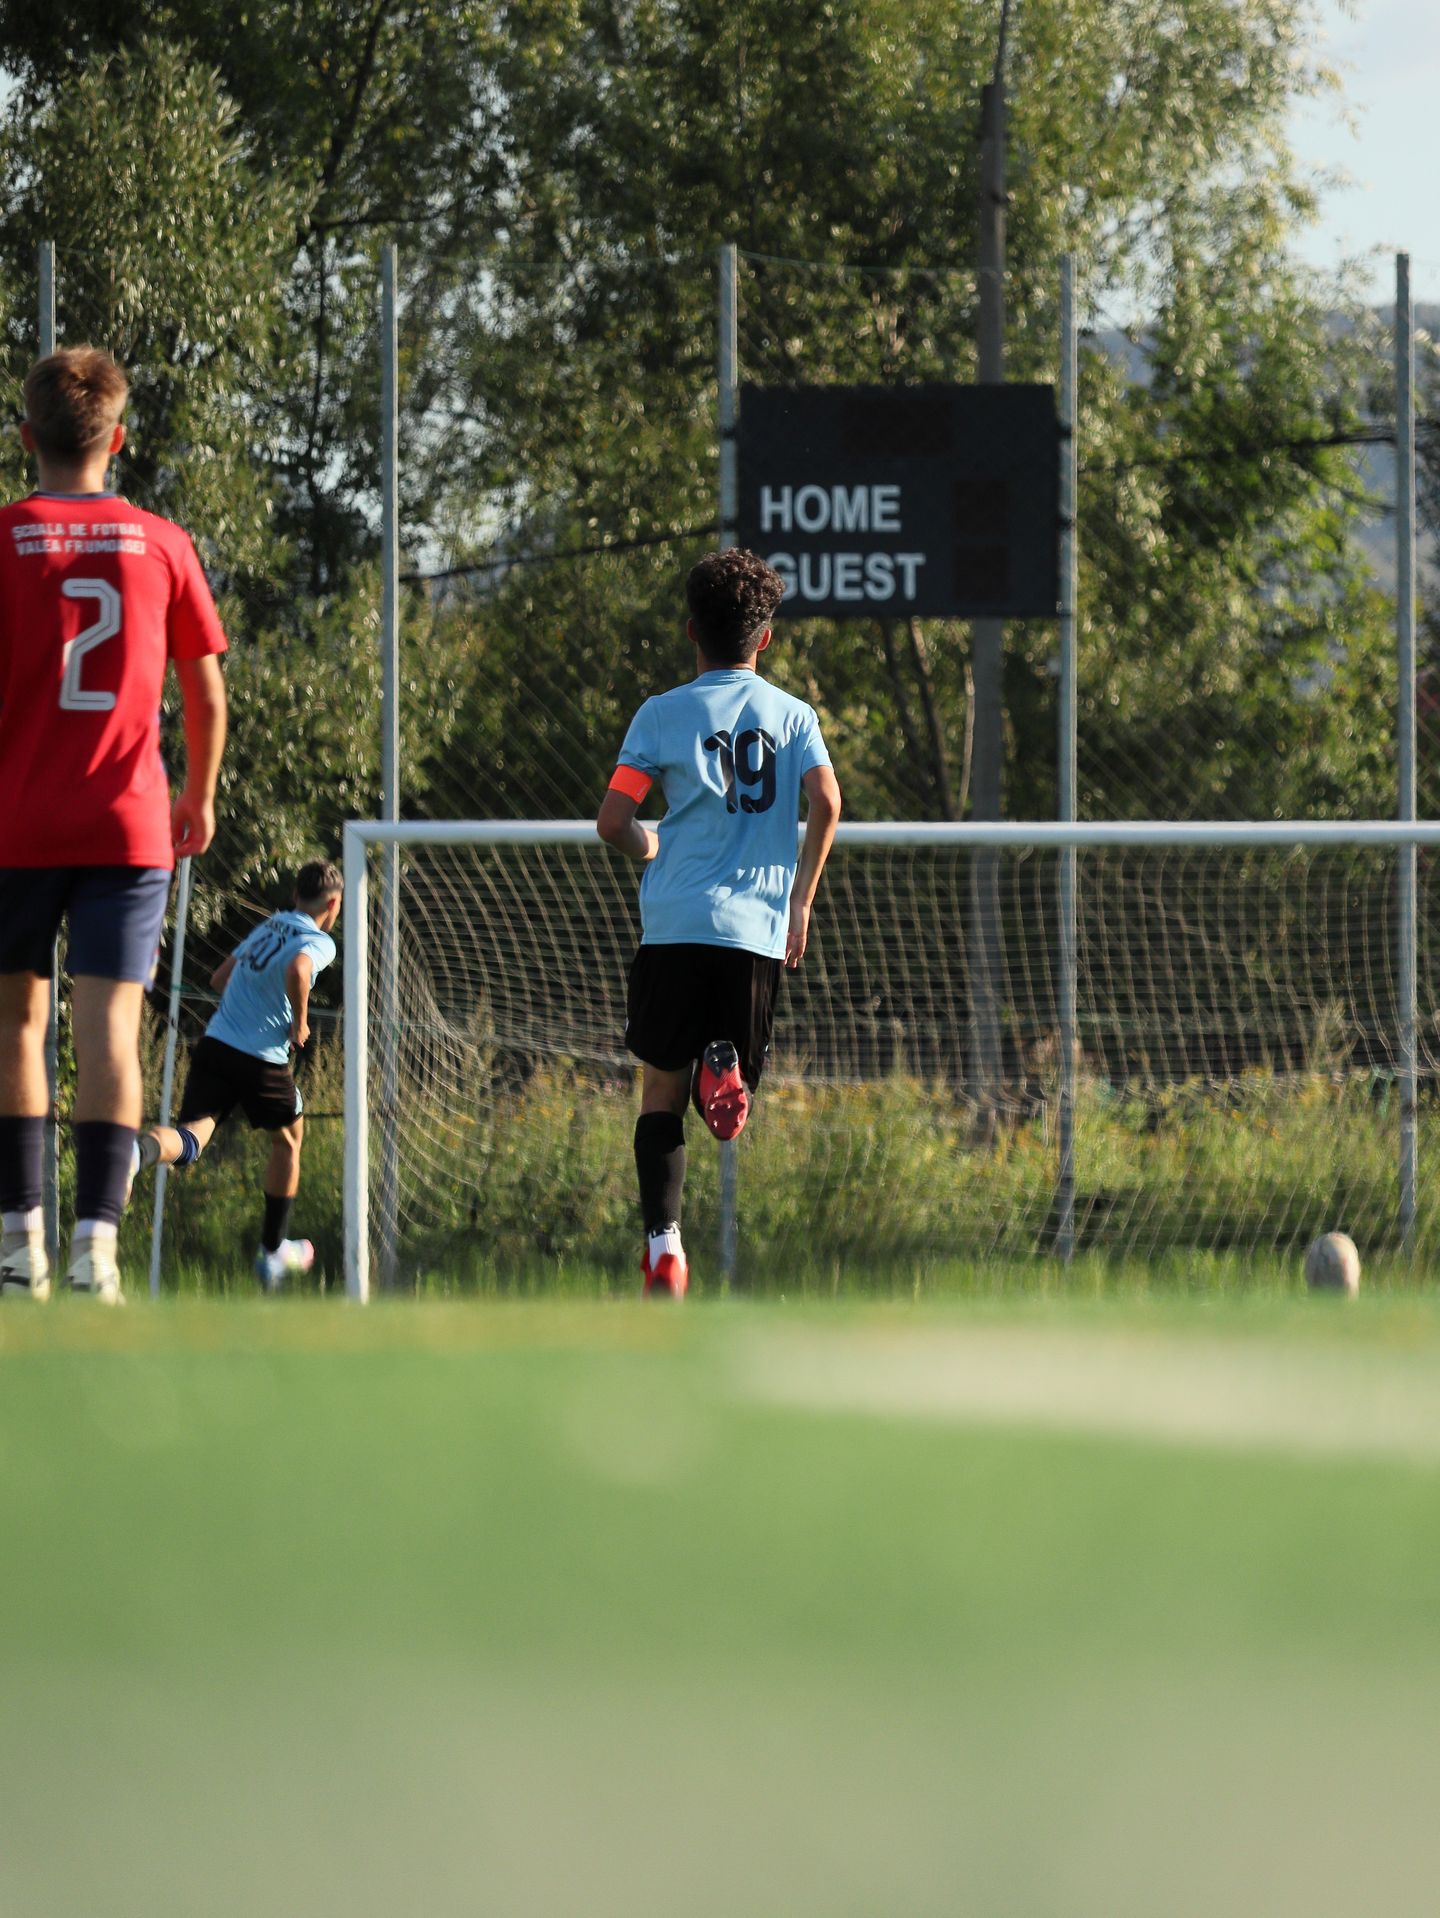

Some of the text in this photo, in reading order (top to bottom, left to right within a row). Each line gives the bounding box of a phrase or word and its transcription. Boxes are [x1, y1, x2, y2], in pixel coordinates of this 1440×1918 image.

[69, 523, 87, 536] DE
[761, 484, 901, 533] HOME
[16, 539, 61, 556] VALEA
[766, 552, 925, 600] GUEST
[59, 578, 120, 710] 2
[703, 727, 776, 814] 19
